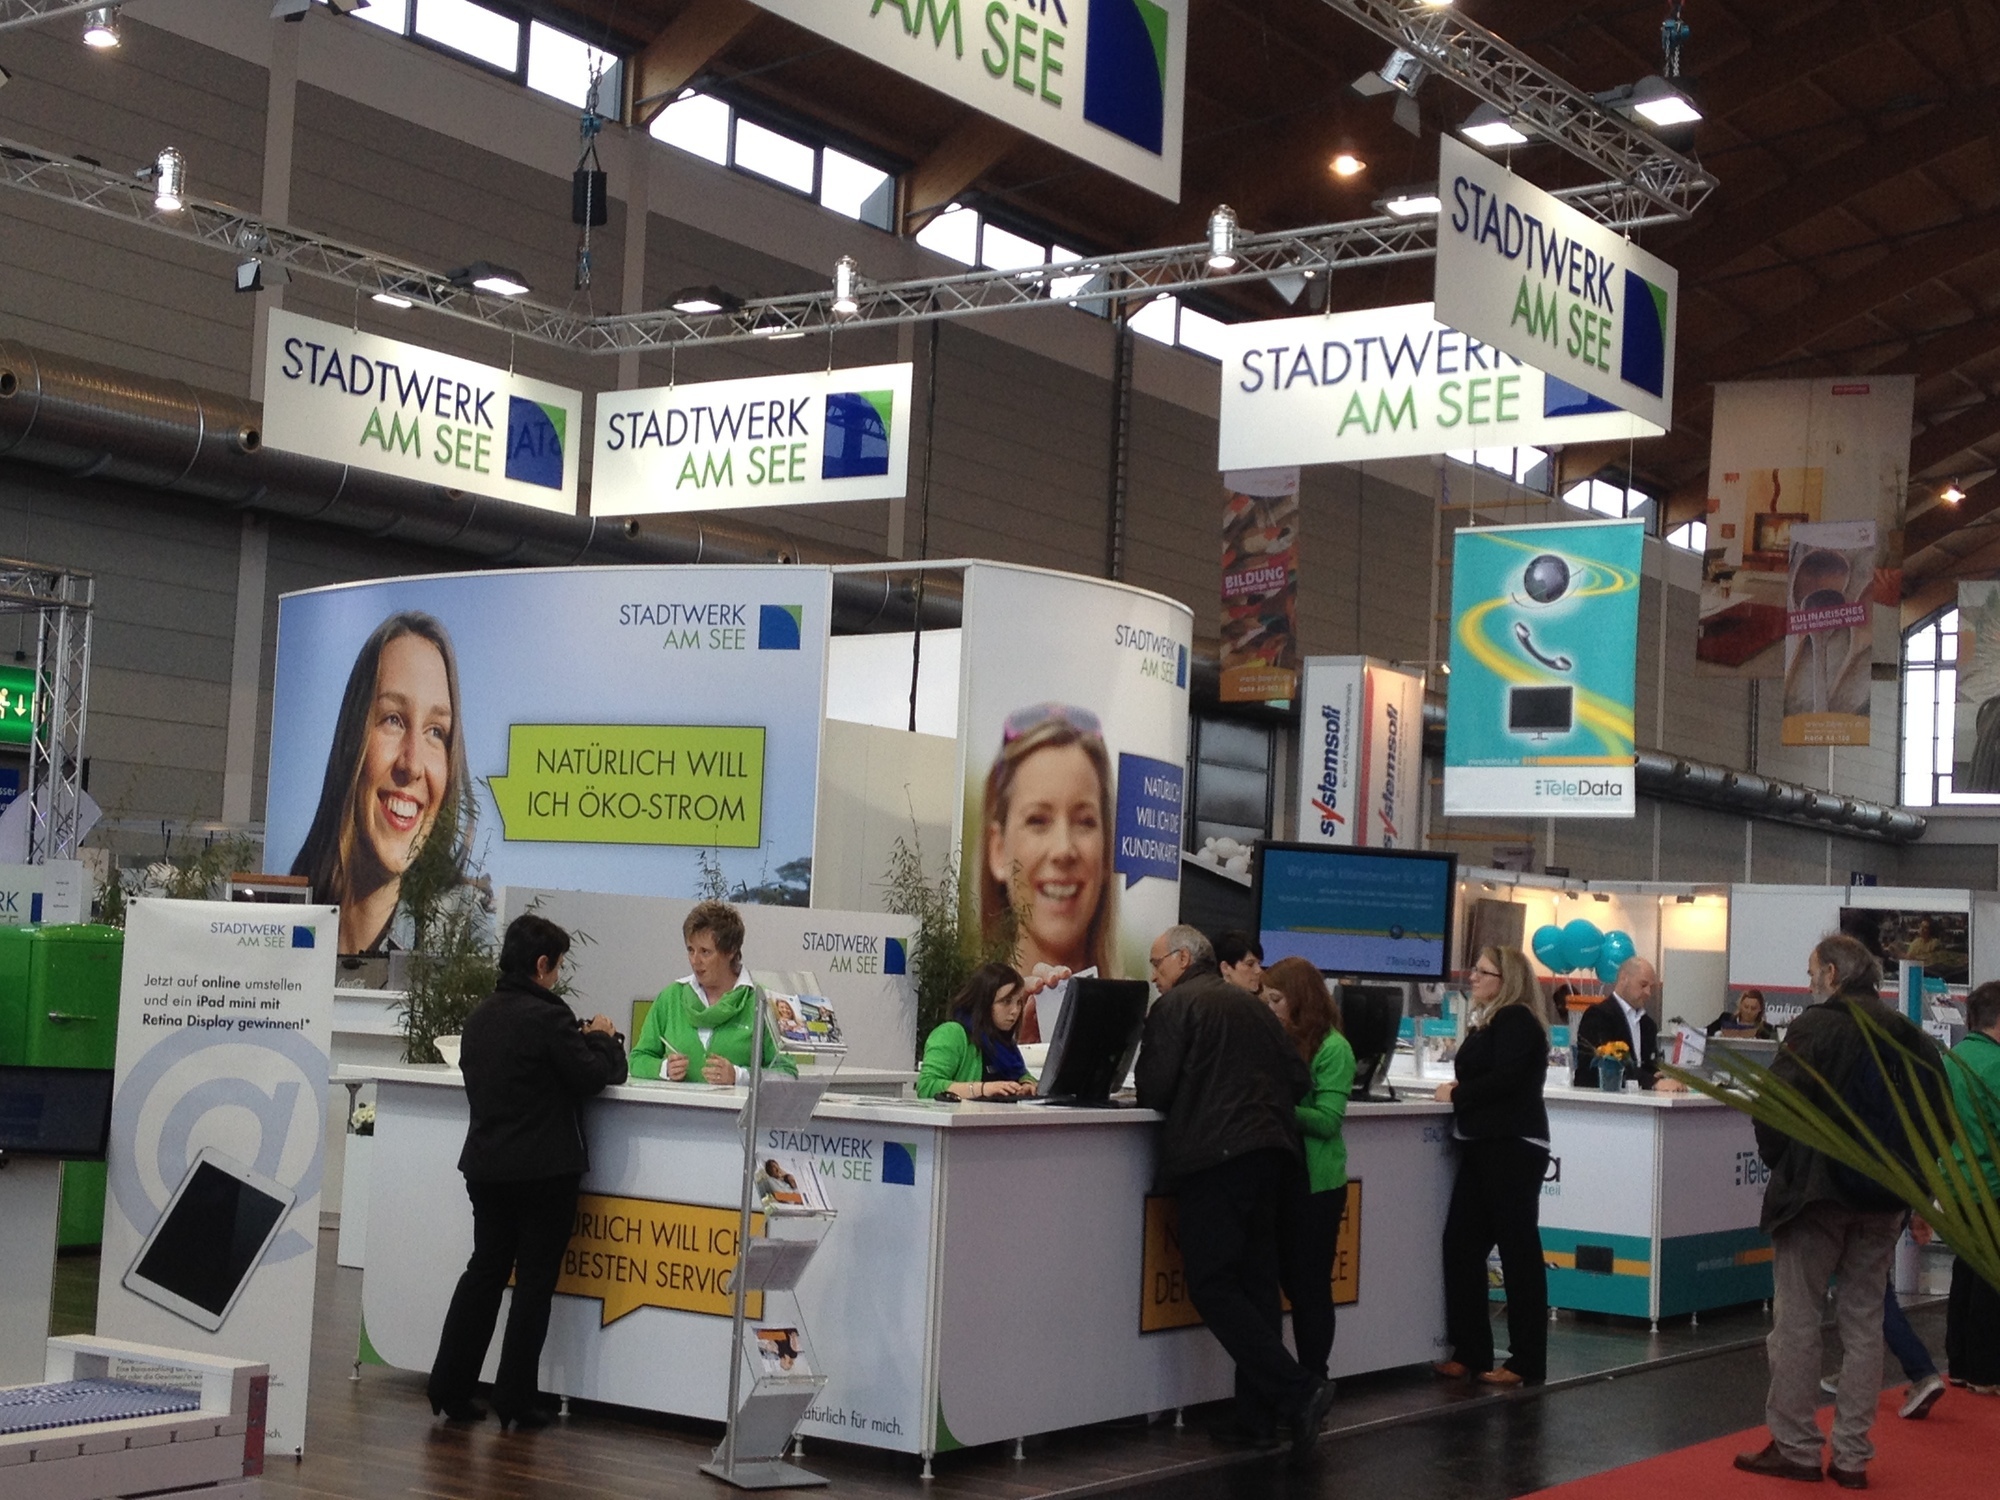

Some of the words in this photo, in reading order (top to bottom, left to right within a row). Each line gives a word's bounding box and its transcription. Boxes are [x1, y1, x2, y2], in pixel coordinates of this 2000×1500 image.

[981, 0, 1064, 106] SEE
[1451, 176, 1614, 313] STADTWERK
[1511, 275, 1558, 348] AM
[1567, 302, 1612, 373] SEE
[282, 337, 496, 430] STADTWERK
[1337, 384, 1418, 438] AM
[1436, 374, 1521, 429] SEE
[607, 396, 810, 451] STADTWERK
[360, 406, 422, 459] AM
[433, 424, 492, 474] SEE
[676, 447, 734, 490] AM
[746, 442, 807, 485] SEE
[1225, 566, 1285, 589] BILDUNG
[619, 603, 747, 626] STADTWERK
[1790, 605, 1864, 624] KULINARISCHES
[663, 629, 701, 650] AM
[708, 628, 747, 650] SEE
[1115, 624, 1176, 660] STADTWERK
[1140, 657, 1160, 680] AM
[1160, 663, 1175, 685] SEE
[537, 742, 676, 776] NATÜRLICH
[687, 750, 748, 778] WILL
[1312, 704, 1346, 838] systemsoft
[1144, 775, 1180, 803] NATÜRLICH
[1378, 703, 1399, 848] systemsoft
[1543, 780, 1622, 796] TeleData
[528, 791, 569, 817] ICH
[578, 785, 746, 822] ÖKO-STROM
[1136, 806, 1156, 829] WILL
[1121, 836, 1178, 864] KUNDENKARTE
[210, 922, 286, 936] STADTWERK
[237, 937, 260, 947] AM
[264, 937, 286, 948] SEE
[802, 932, 878, 954] STADTWERK
[829, 956, 851, 973] AM
[856, 956, 878, 974] SEE
[144, 974, 173, 987] Jetzt
[177, 974, 199, 987] auf
[201, 976, 241, 989] online
[245, 978, 302, 991] umstellen
[144, 994, 168, 1007] und
[172, 996, 192, 1007] ein
[196, 995, 225, 1008] iPad
[229, 996, 256, 1009] mini
[260, 997, 281, 1010] mit
[142, 1013, 182, 1027] Retina
[187, 1015, 234, 1031] Display
[768, 1130, 873, 1159] STADTWERK
[842, 1159, 873, 1182] SEE
[1742, 1151, 1771, 1185] Tele
[651, 1220, 699, 1252] WILL
[565, 1250, 647, 1284] BESTEN
[655, 1261, 734, 1296] SERVIC
[1155, 1270, 1185, 1305] DE
[265, 1429, 282, 1439] ich.
[801, 1405, 847, 1426] atürlich
[851, 1409, 867, 1429] für
[871, 1416, 904, 1436] mich.
